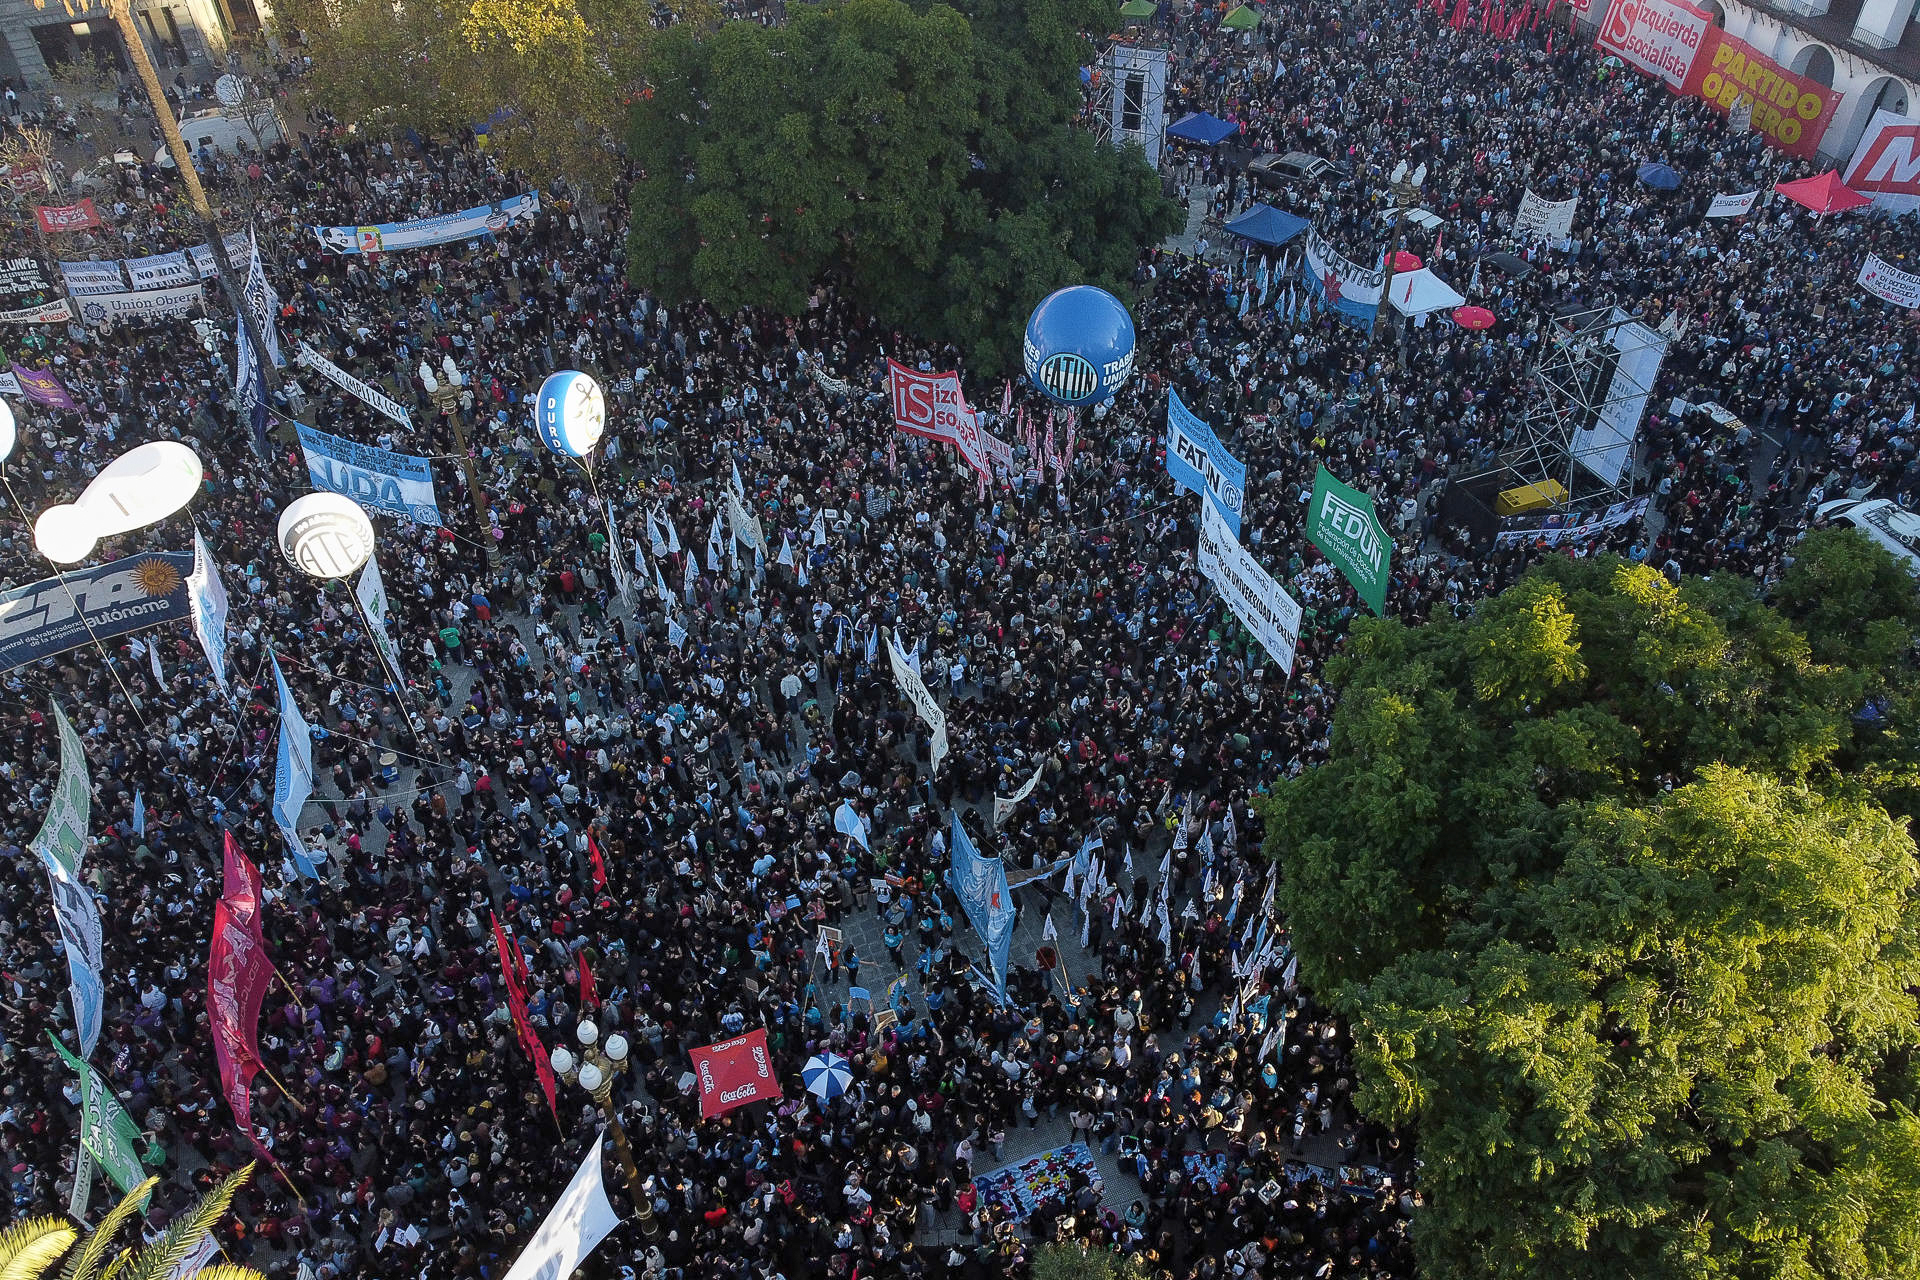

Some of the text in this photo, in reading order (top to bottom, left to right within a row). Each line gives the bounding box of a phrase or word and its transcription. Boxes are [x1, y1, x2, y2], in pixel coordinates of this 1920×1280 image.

[1637, 4, 1700, 49] izquierda
[1626, 35, 1687, 80] socialista
[1712, 42, 1823, 120] PARTIDO
[136, 265, 182, 281] NO HAY
[1308, 226, 1384, 288] NCUENTRO
[1879, 263, 1897, 276] OTTO
[68, 274, 118, 283] UNIVERSIDAD
[111, 293, 199, 310] Unión Obrera
[1045, 356, 1094, 400] FATUN
[323, 457, 411, 513] UDA
[1318, 521, 1351, 550] Federación
[1320, 490, 1383, 573] FEDUN
[299, 531, 360, 576] ATE
[1239, 557, 1270, 592] conadu
[87, 599, 170, 628] autónoma
[0, 639, 24, 652] entral
[49, 624, 87, 641] argentina
